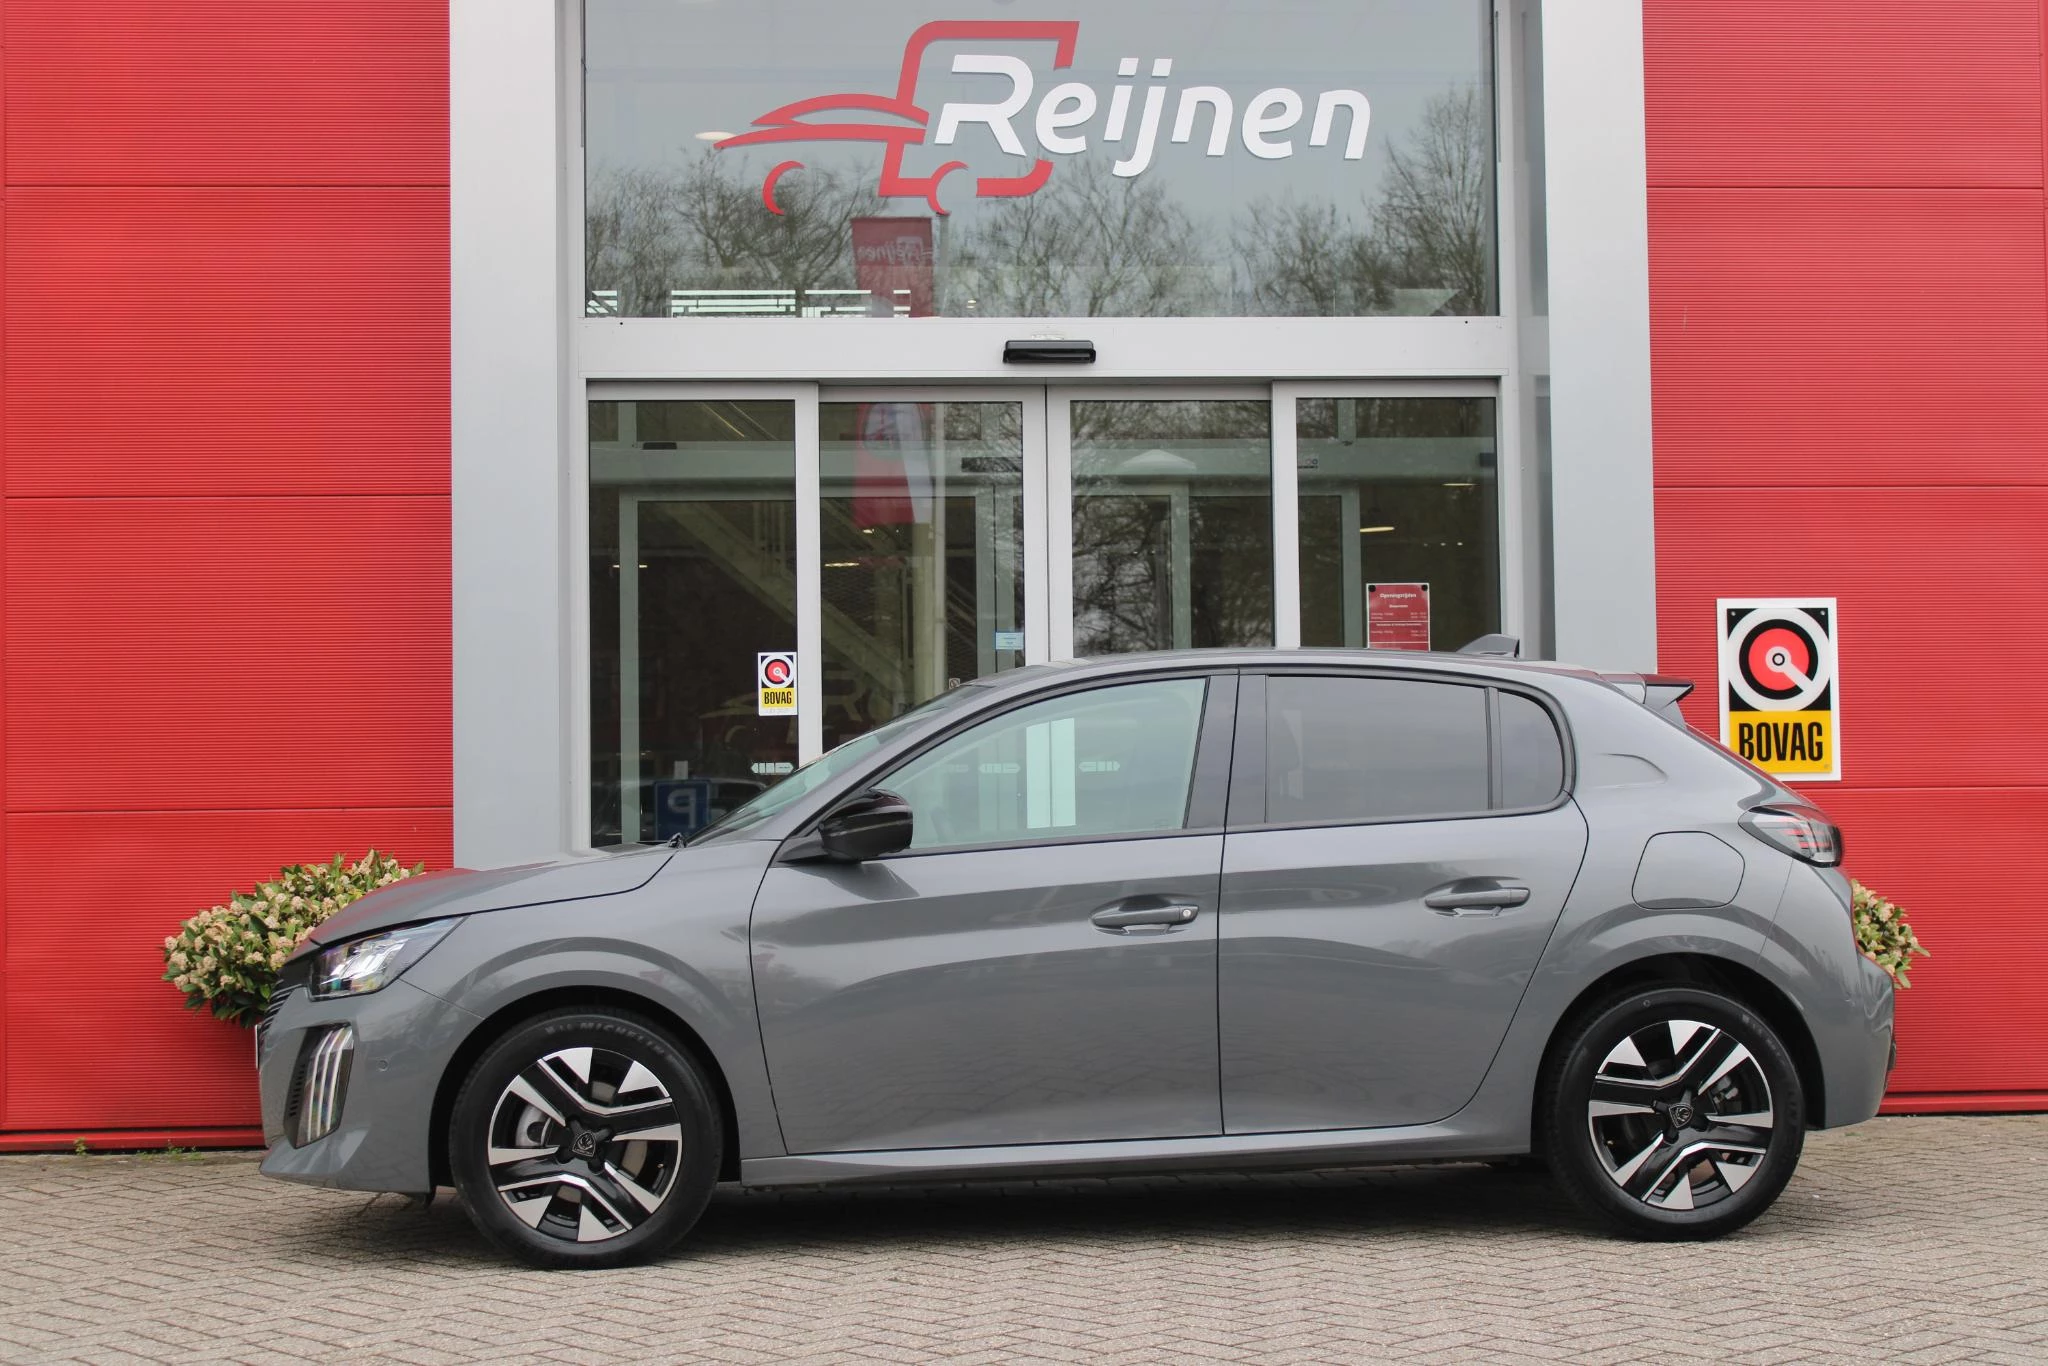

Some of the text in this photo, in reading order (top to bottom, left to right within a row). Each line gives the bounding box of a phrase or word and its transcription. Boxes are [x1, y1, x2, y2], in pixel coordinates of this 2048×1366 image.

[934, 54, 1372, 177] Reijnen
[764, 691, 792, 705] BOVAG
[1738, 722, 1823, 762] BOVAG
